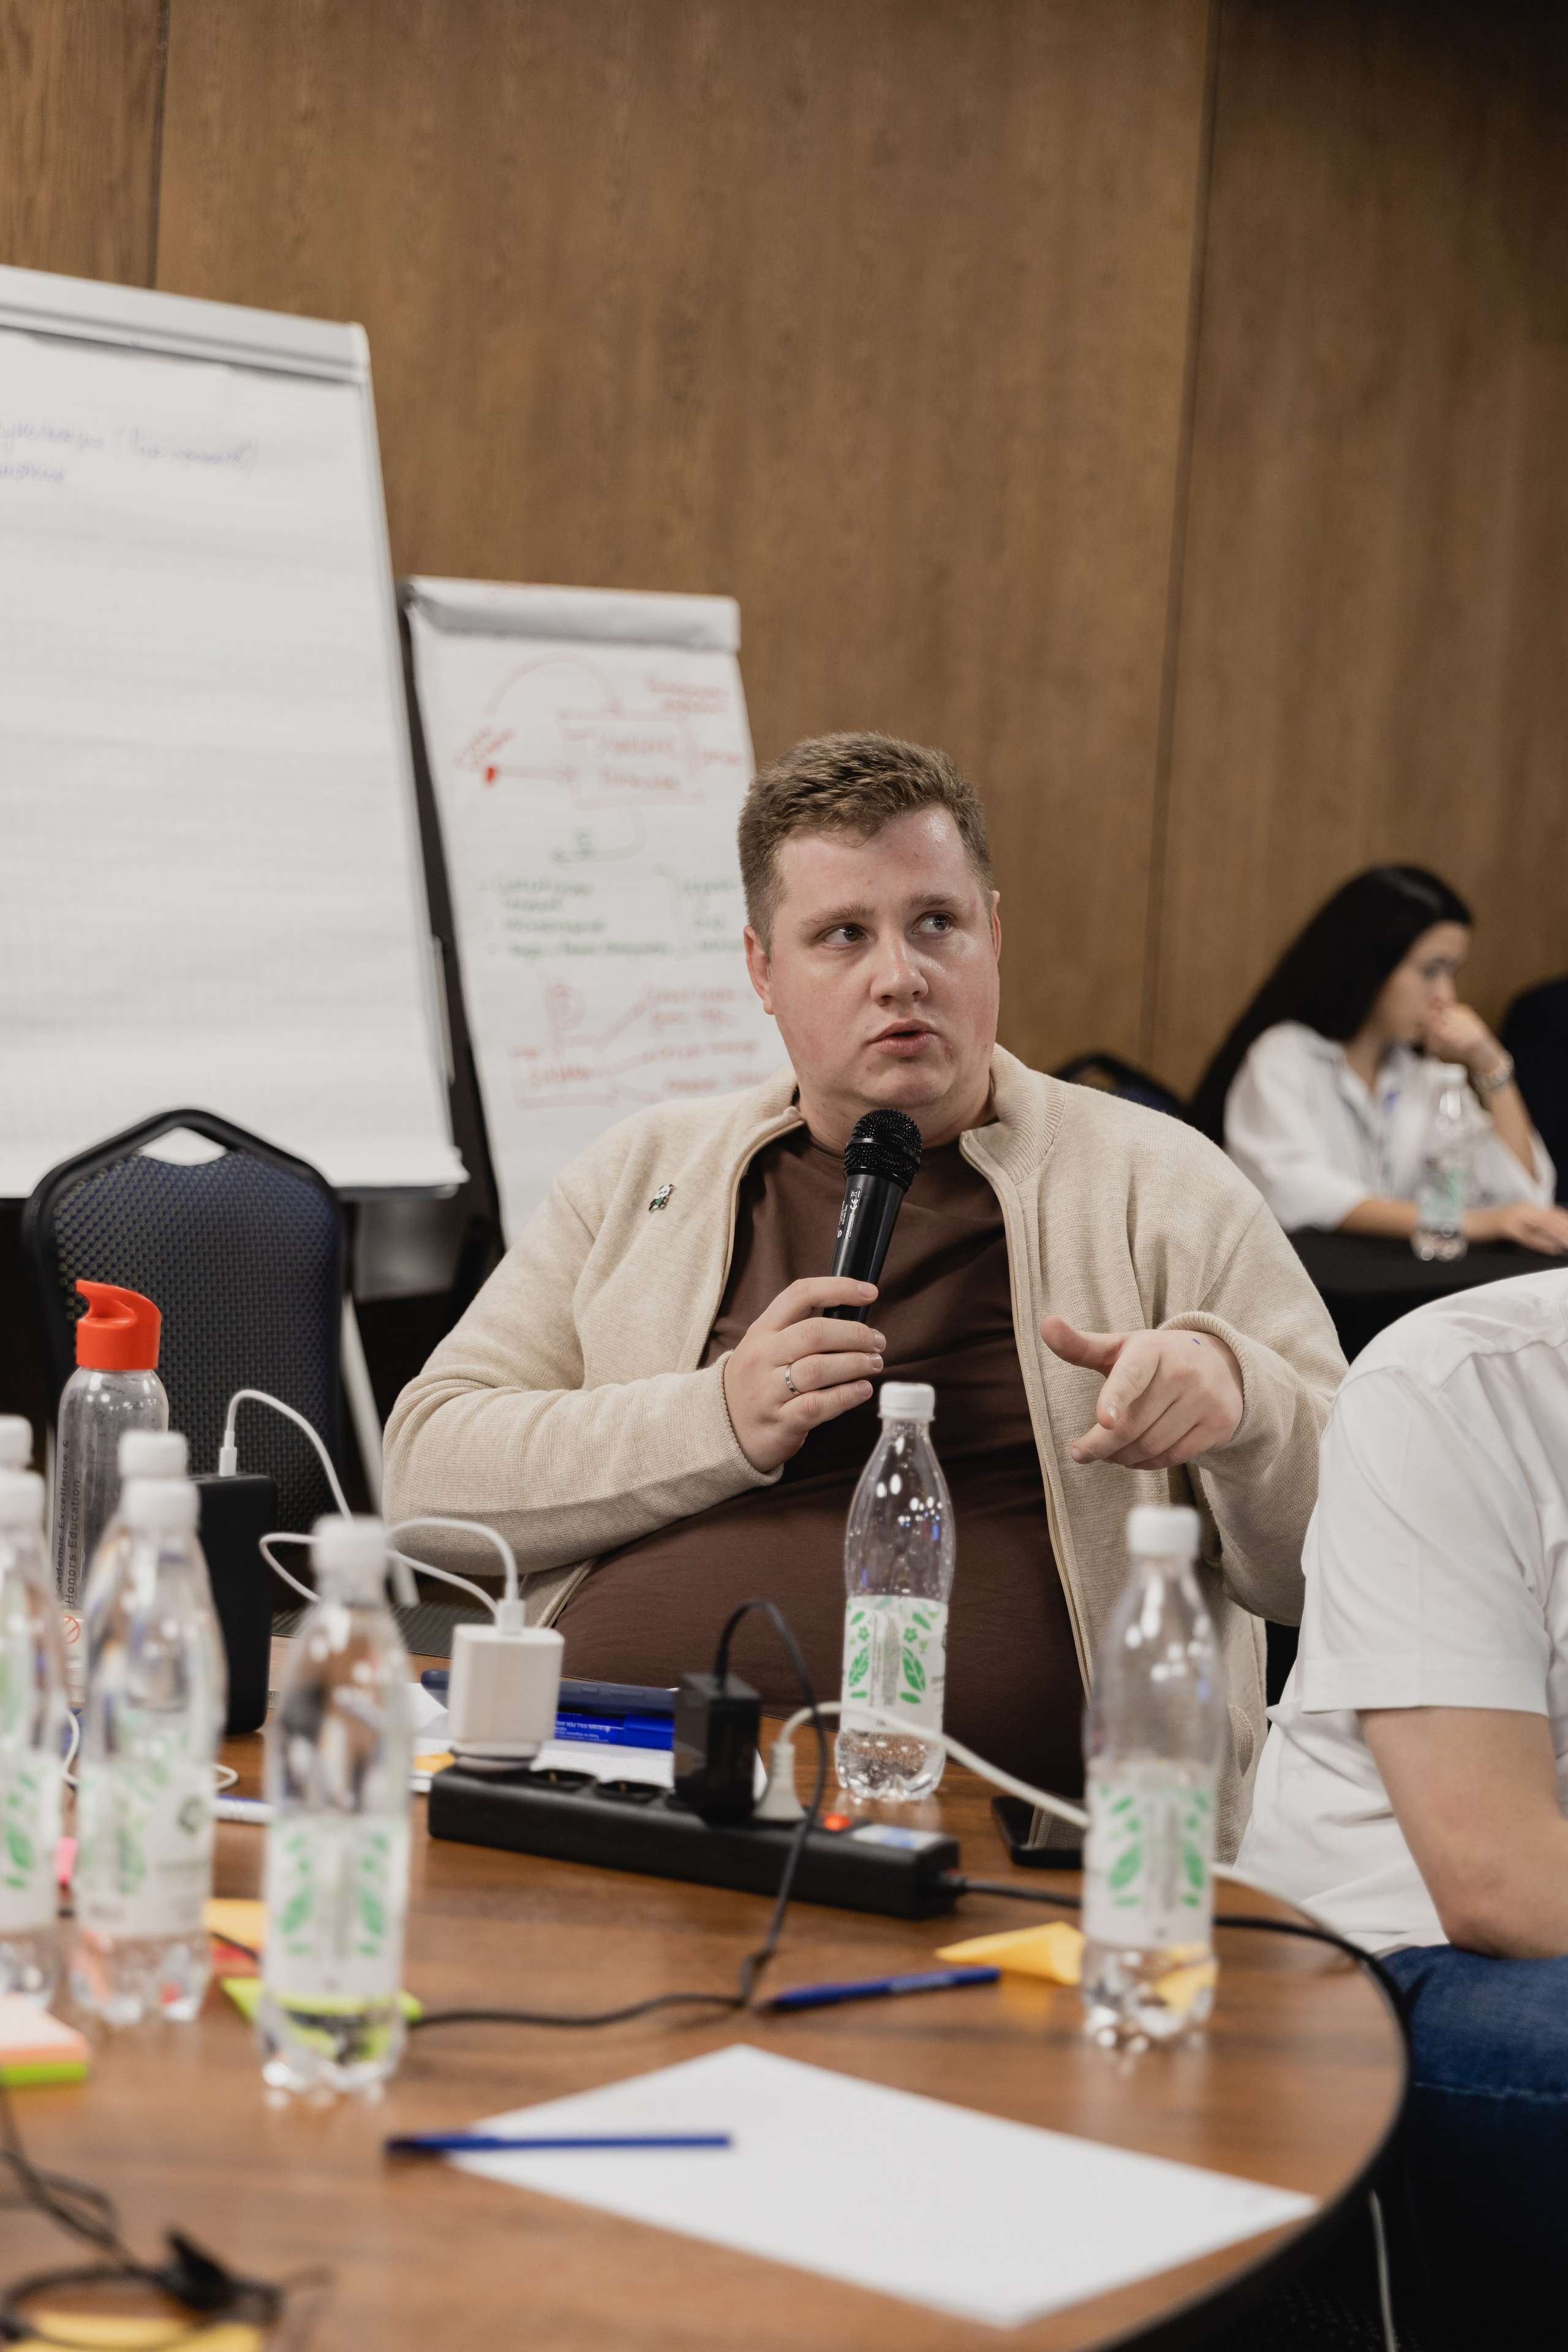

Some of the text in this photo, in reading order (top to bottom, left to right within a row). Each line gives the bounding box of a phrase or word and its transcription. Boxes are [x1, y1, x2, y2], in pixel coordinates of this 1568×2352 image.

[62, 1439, 69, 1449] &
[58, 1454, 69, 1529] Excellence
[65, 1480, 81, 1604] Honors Education
